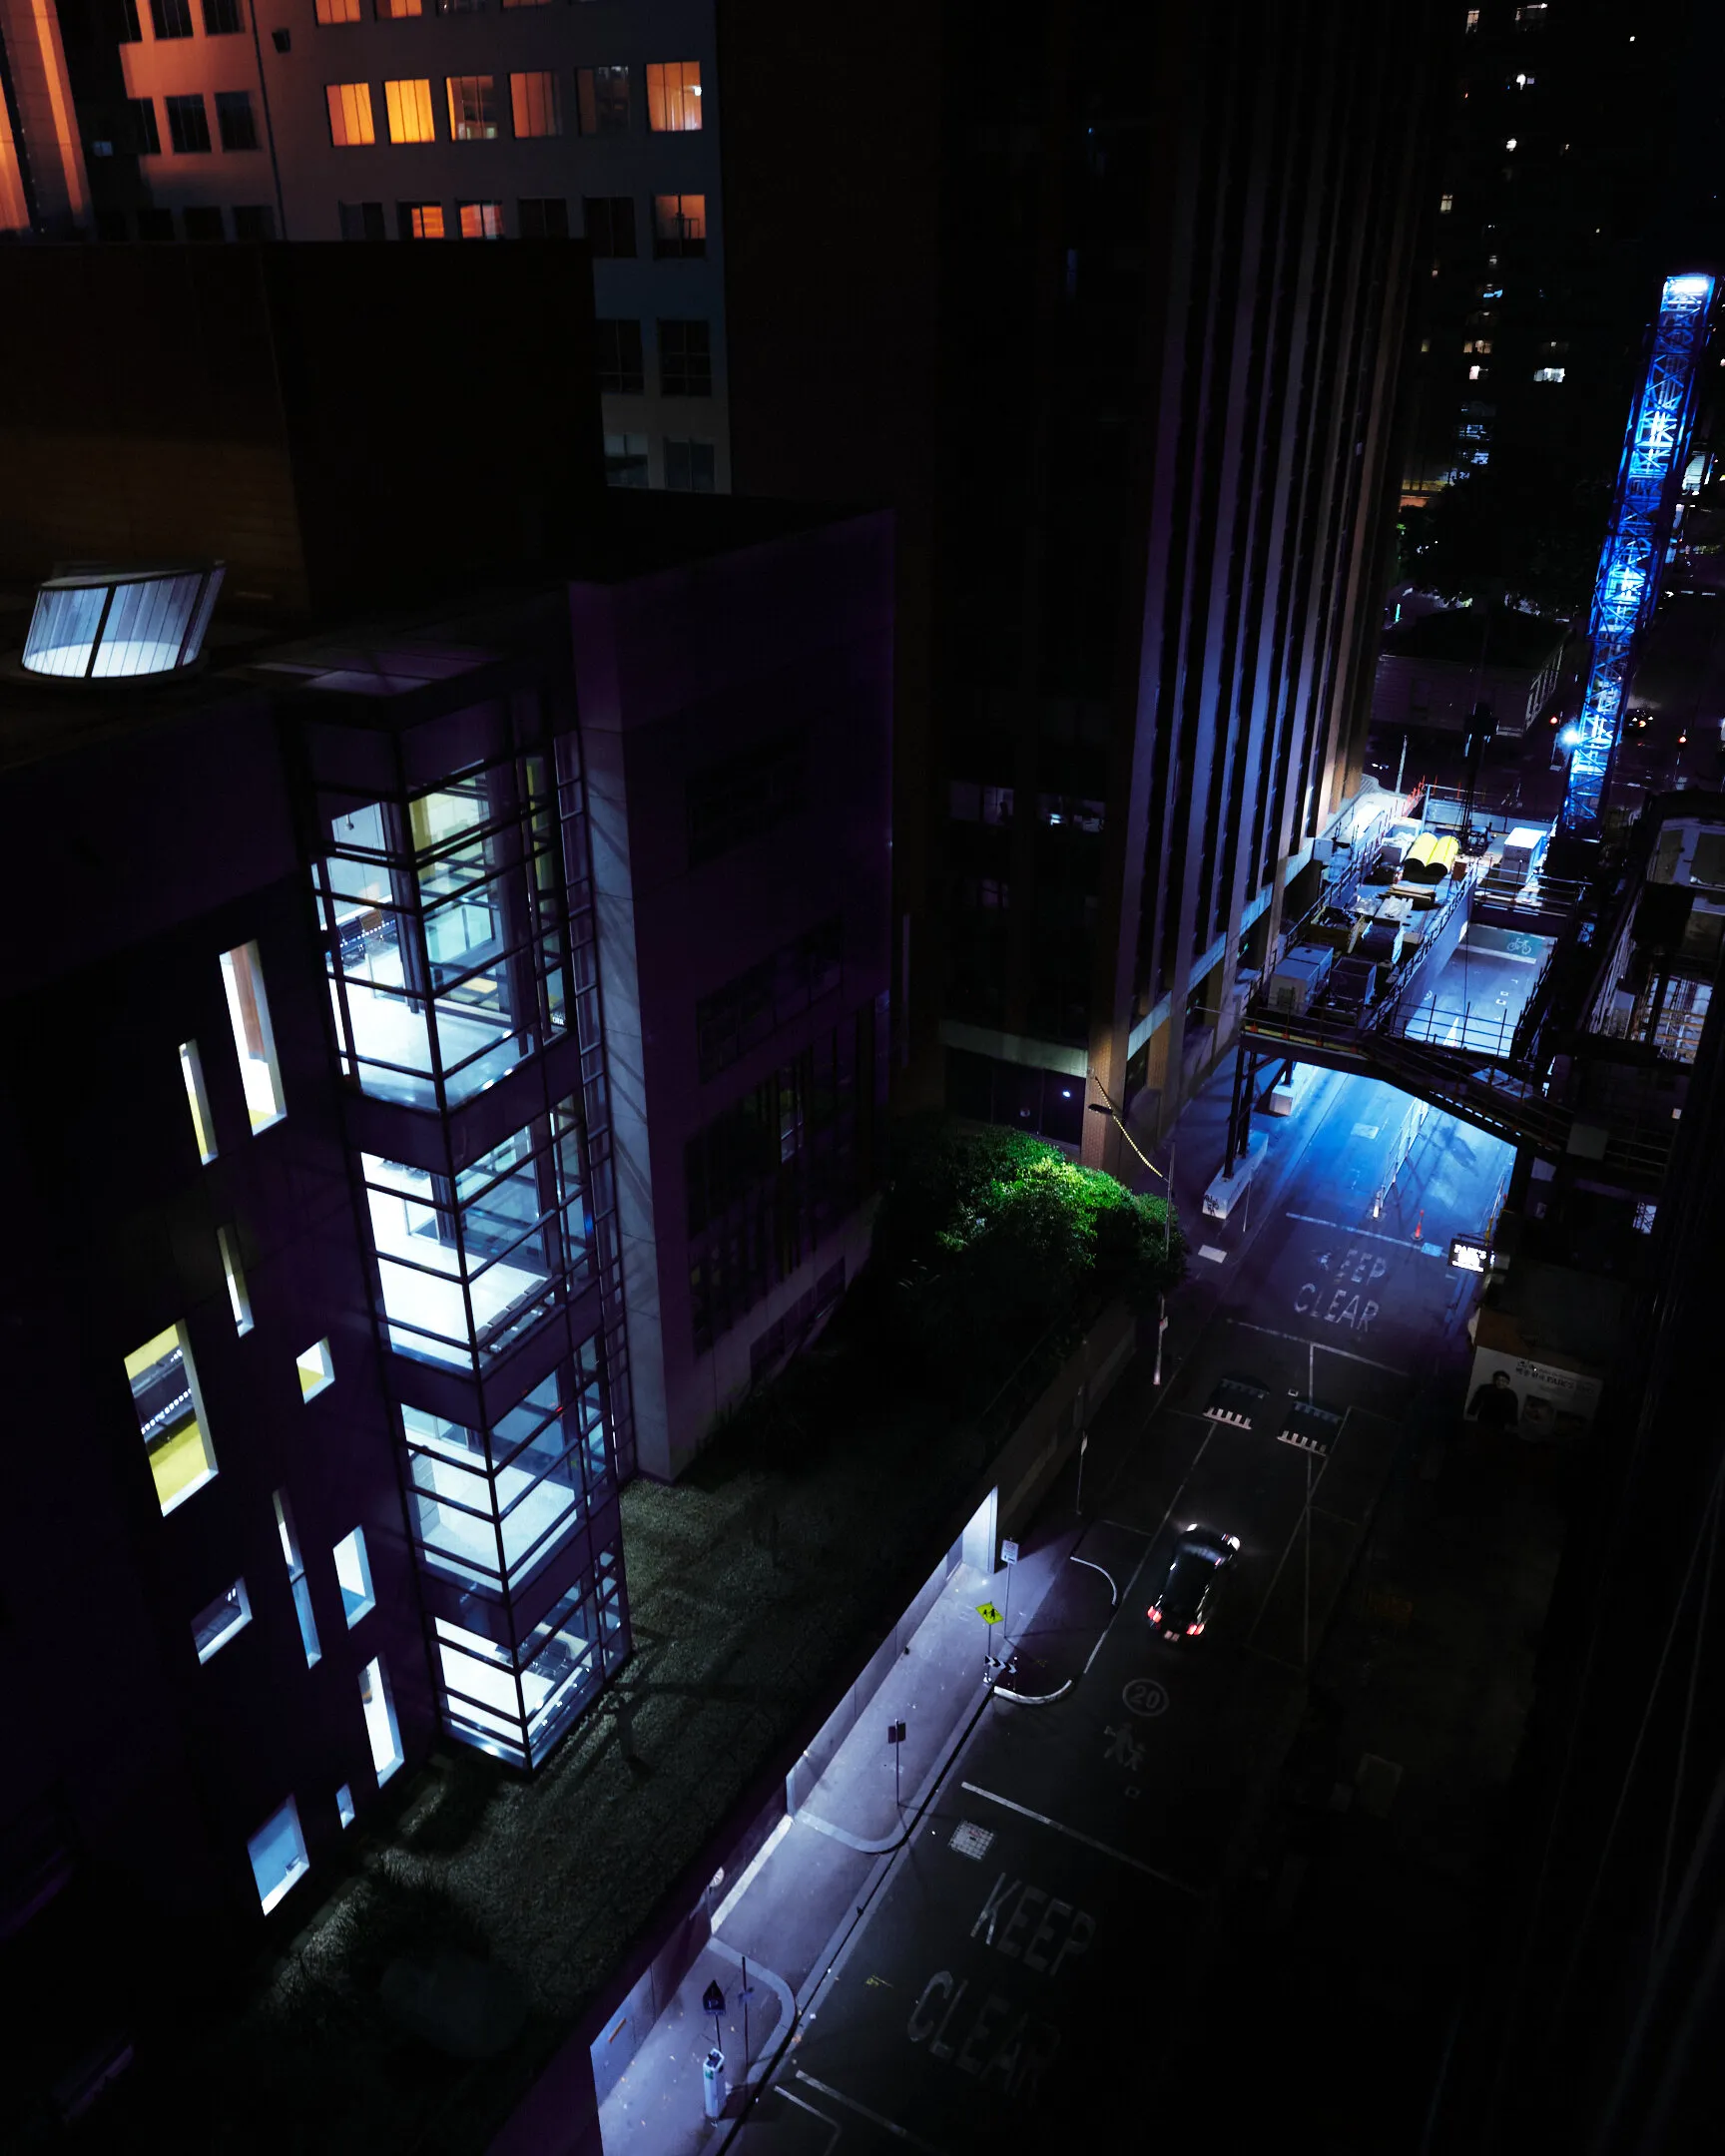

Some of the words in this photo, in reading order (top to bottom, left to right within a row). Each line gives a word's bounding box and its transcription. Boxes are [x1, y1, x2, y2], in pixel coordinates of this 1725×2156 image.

[1294, 1283, 1380, 1333] CLEAR
[1130, 1685, 1161, 1709] 20
[969, 1872, 1097, 1976] KEEP
[907, 1970, 1062, 2110] CLEAR
